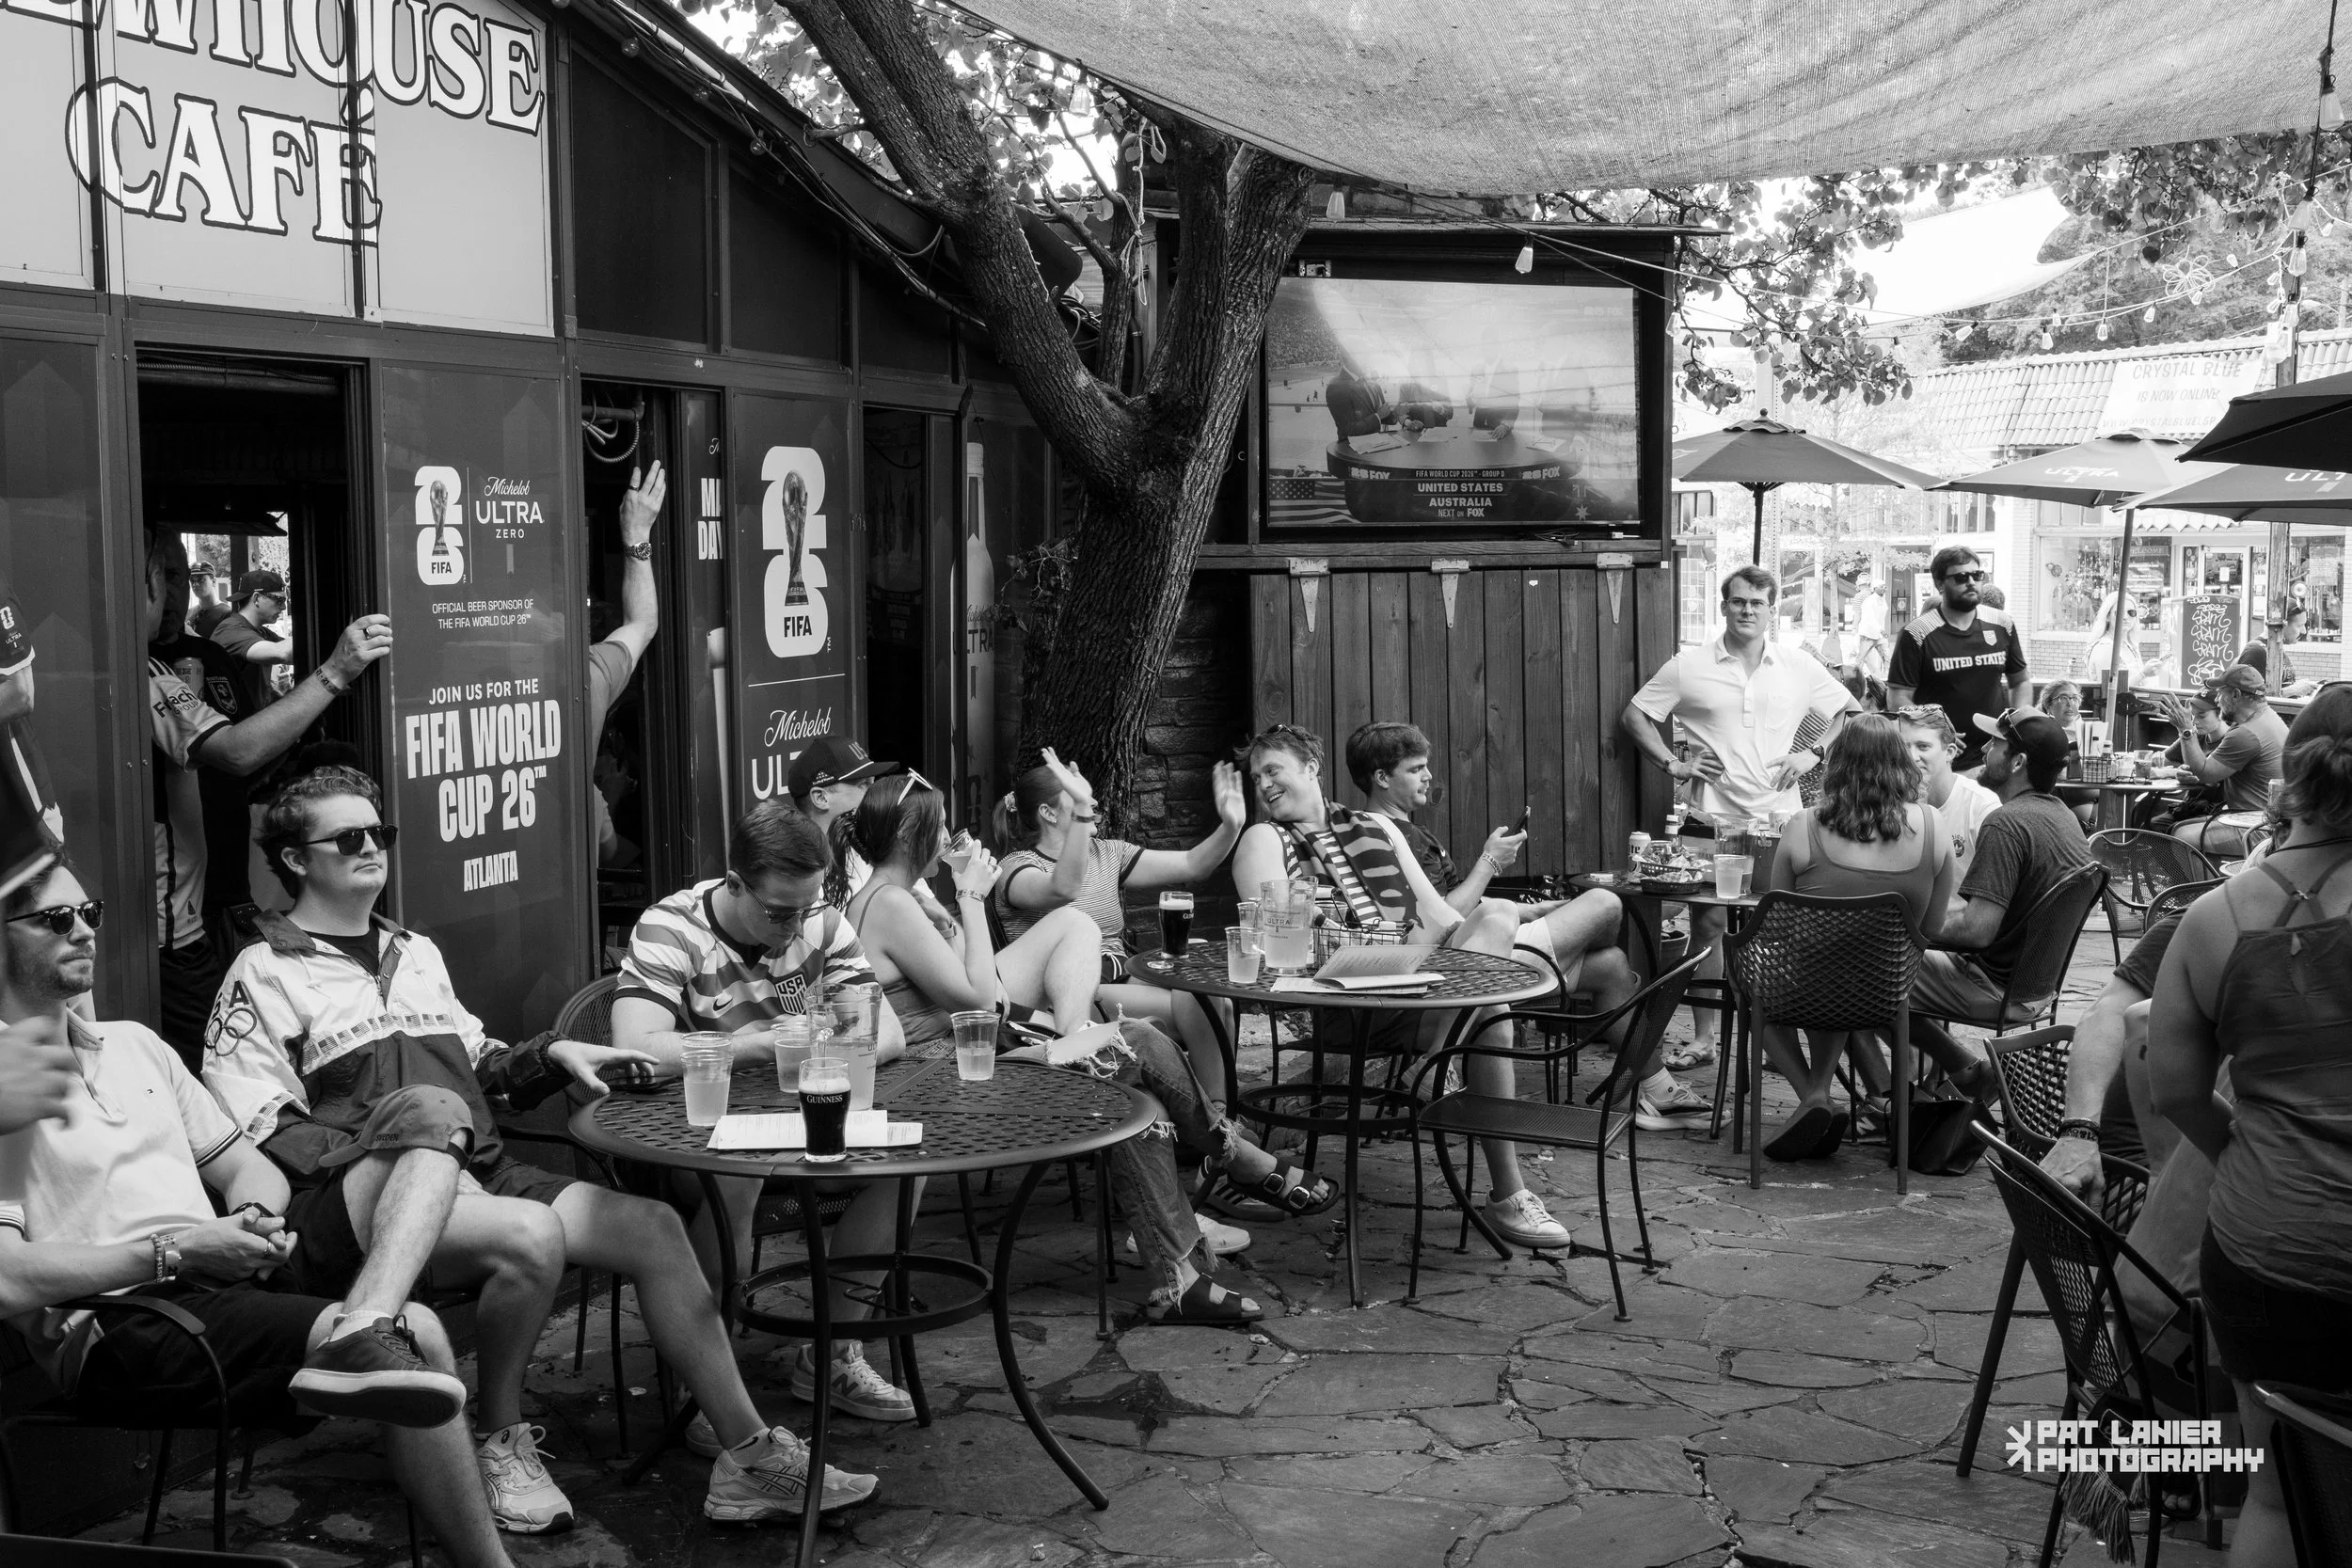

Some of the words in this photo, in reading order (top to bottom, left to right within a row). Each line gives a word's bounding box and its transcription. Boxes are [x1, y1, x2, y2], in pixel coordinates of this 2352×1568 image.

[2132, 363, 2195, 380] CRYSTAL
[2203, 361, 2243, 378] BLUE
[2137, 391, 2147, 403] IS
[2151, 389, 2176, 402] NOW
[2180, 388, 2220, 401] ONLINE
[485, 477, 530, 496] Michelob
[1418, 483, 1458, 492] UNITED
[1460, 483, 1503, 492] STATES
[1429, 498, 1492, 507] AUSTRALIA
[476, 500, 543, 524] ULTRA
[1438, 509, 1455, 517] NEXT
[1467, 508, 1485, 517] FOX
[496, 529, 524, 539] ZERO
[431, 562, 452, 574] FIFA
[432, 602, 466, 613] OFFICIAL
[468, 601, 486, 612] BEER
[488, 600, 523, 611] SPONSOR
[524, 598, 533, 609] OF
[438, 618, 453, 629] THE
[454, 617, 470, 628] FIFA
[471, 615, 499, 627] WORLD
[501, 614, 516, 626] CUP
[783, 615, 812, 638] FIFA
[6, 632, 23, 644] ULTRA
[1931, 655, 1974, 673] UNITED
[428, 685, 461, 705] JOIN
[466, 683, 483, 701] US
[486, 680, 512, 699] FOR
[515, 678, 539, 695] THE
[764, 707, 831, 747] Michelob
[405, 709, 464, 779] FIFA
[470, 699, 562, 768] WORLD
[438, 773, 494, 842] CUP
[464, 850, 518, 892] ATLANTA
